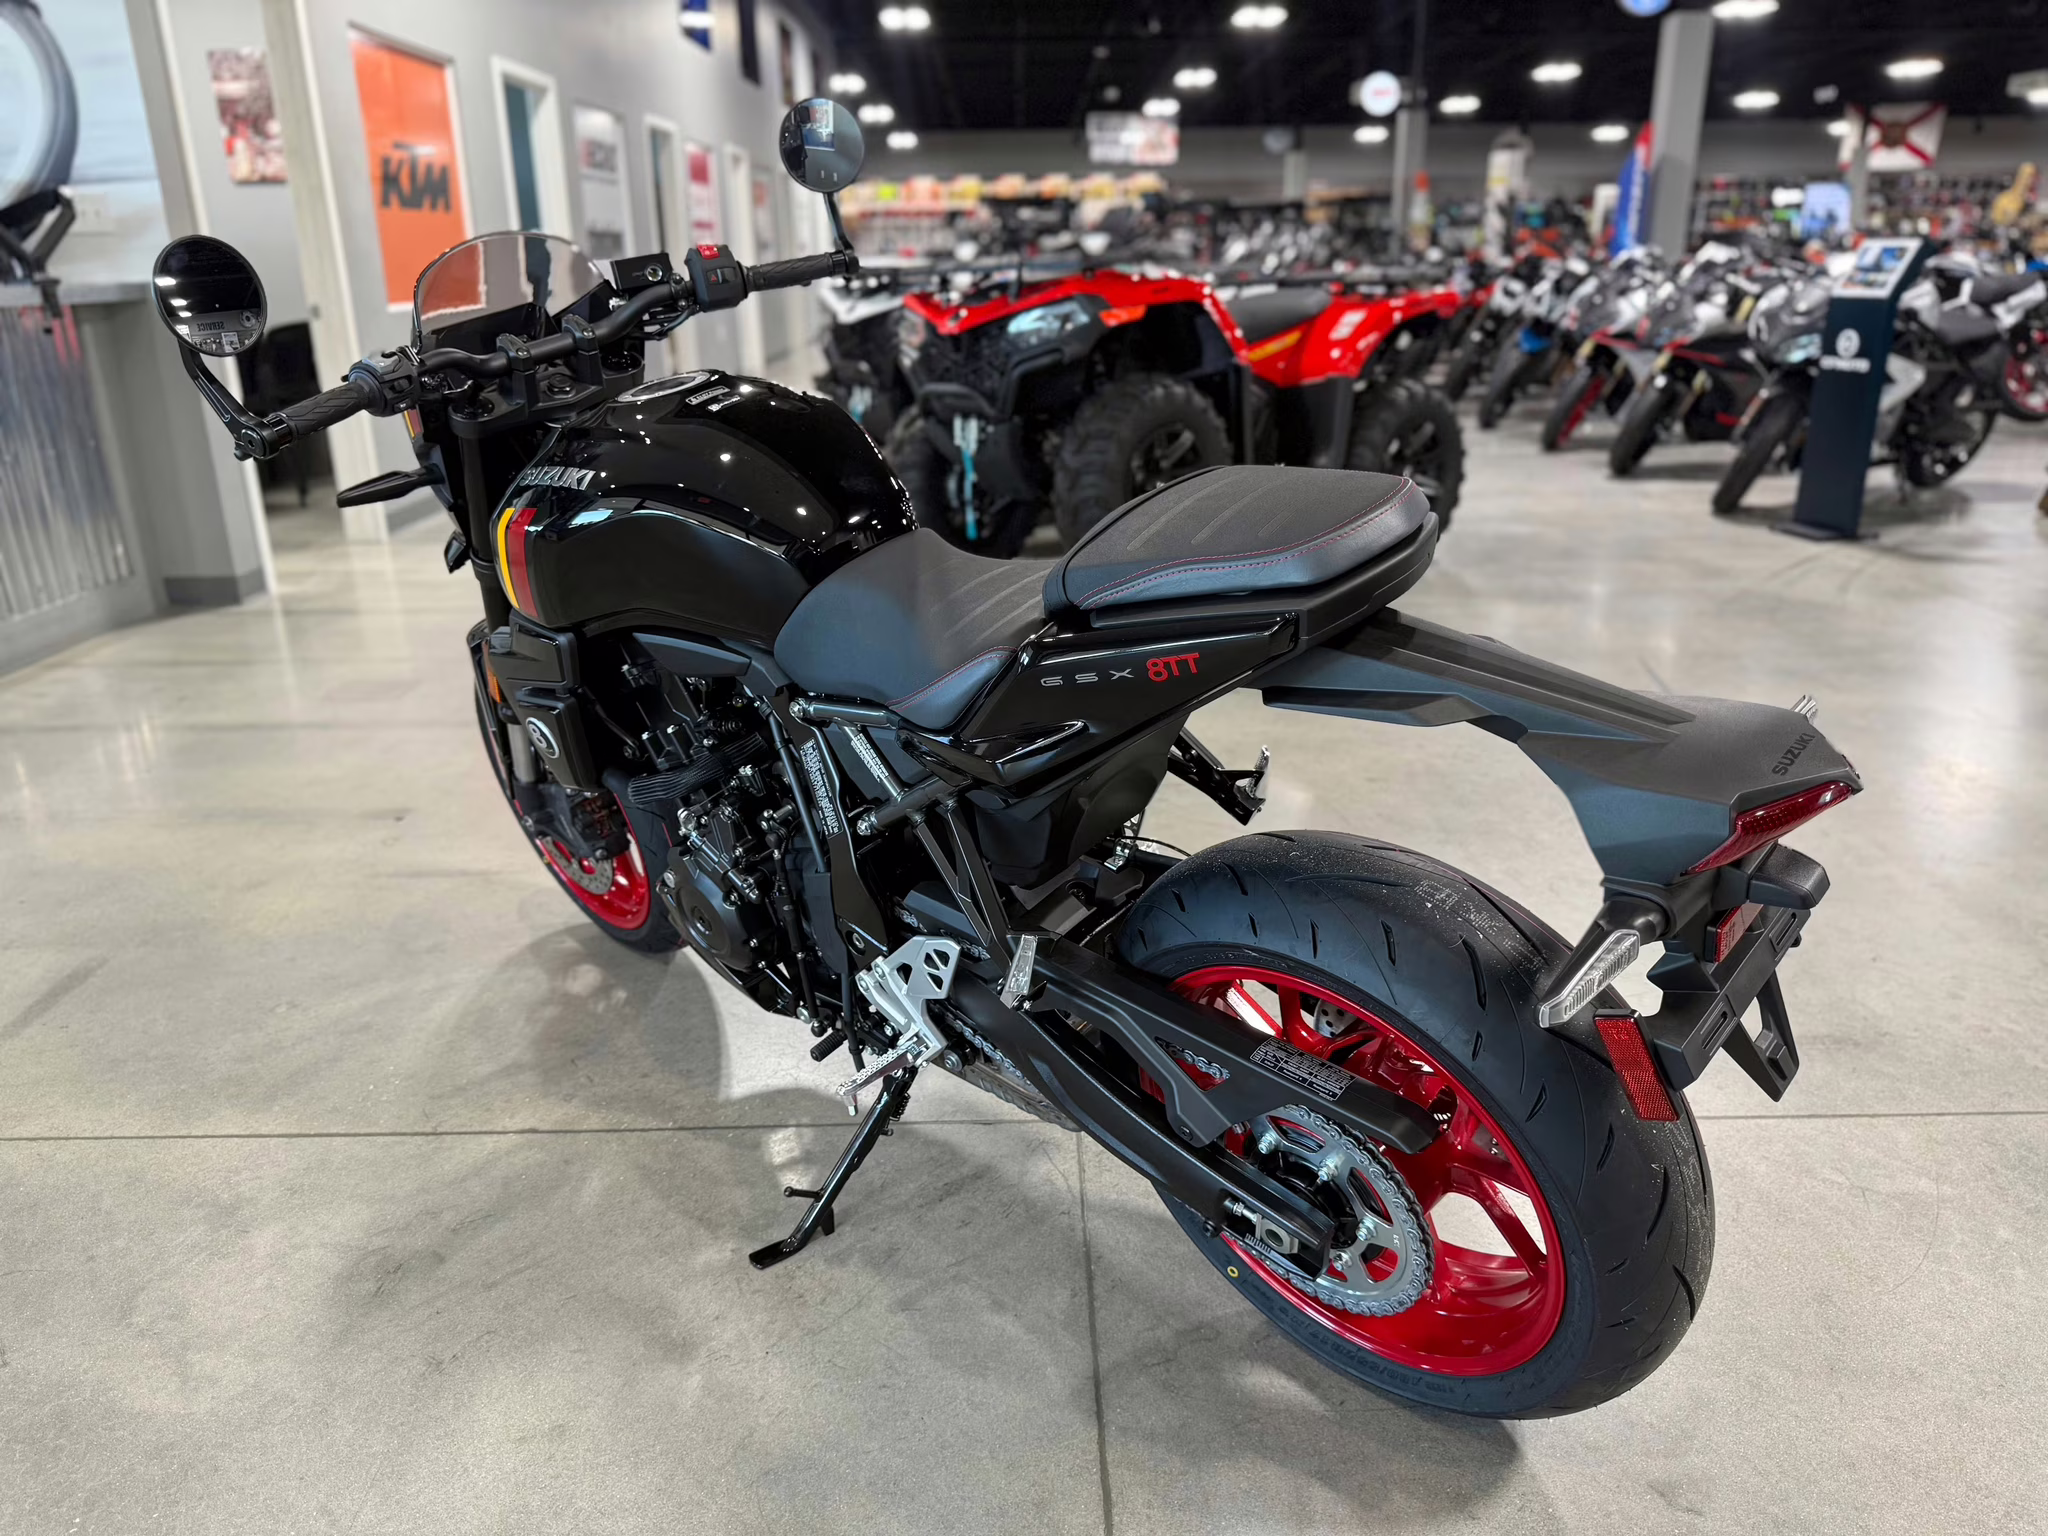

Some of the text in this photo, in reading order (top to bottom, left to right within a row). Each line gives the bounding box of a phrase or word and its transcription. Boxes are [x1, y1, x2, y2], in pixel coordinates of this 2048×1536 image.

[382, 142, 449, 212] KTM
[519, 466, 597, 491] SUZUKI
[1146, 652, 1200, 682] 8TT
[1771, 733, 1816, 776] SUZUKI
